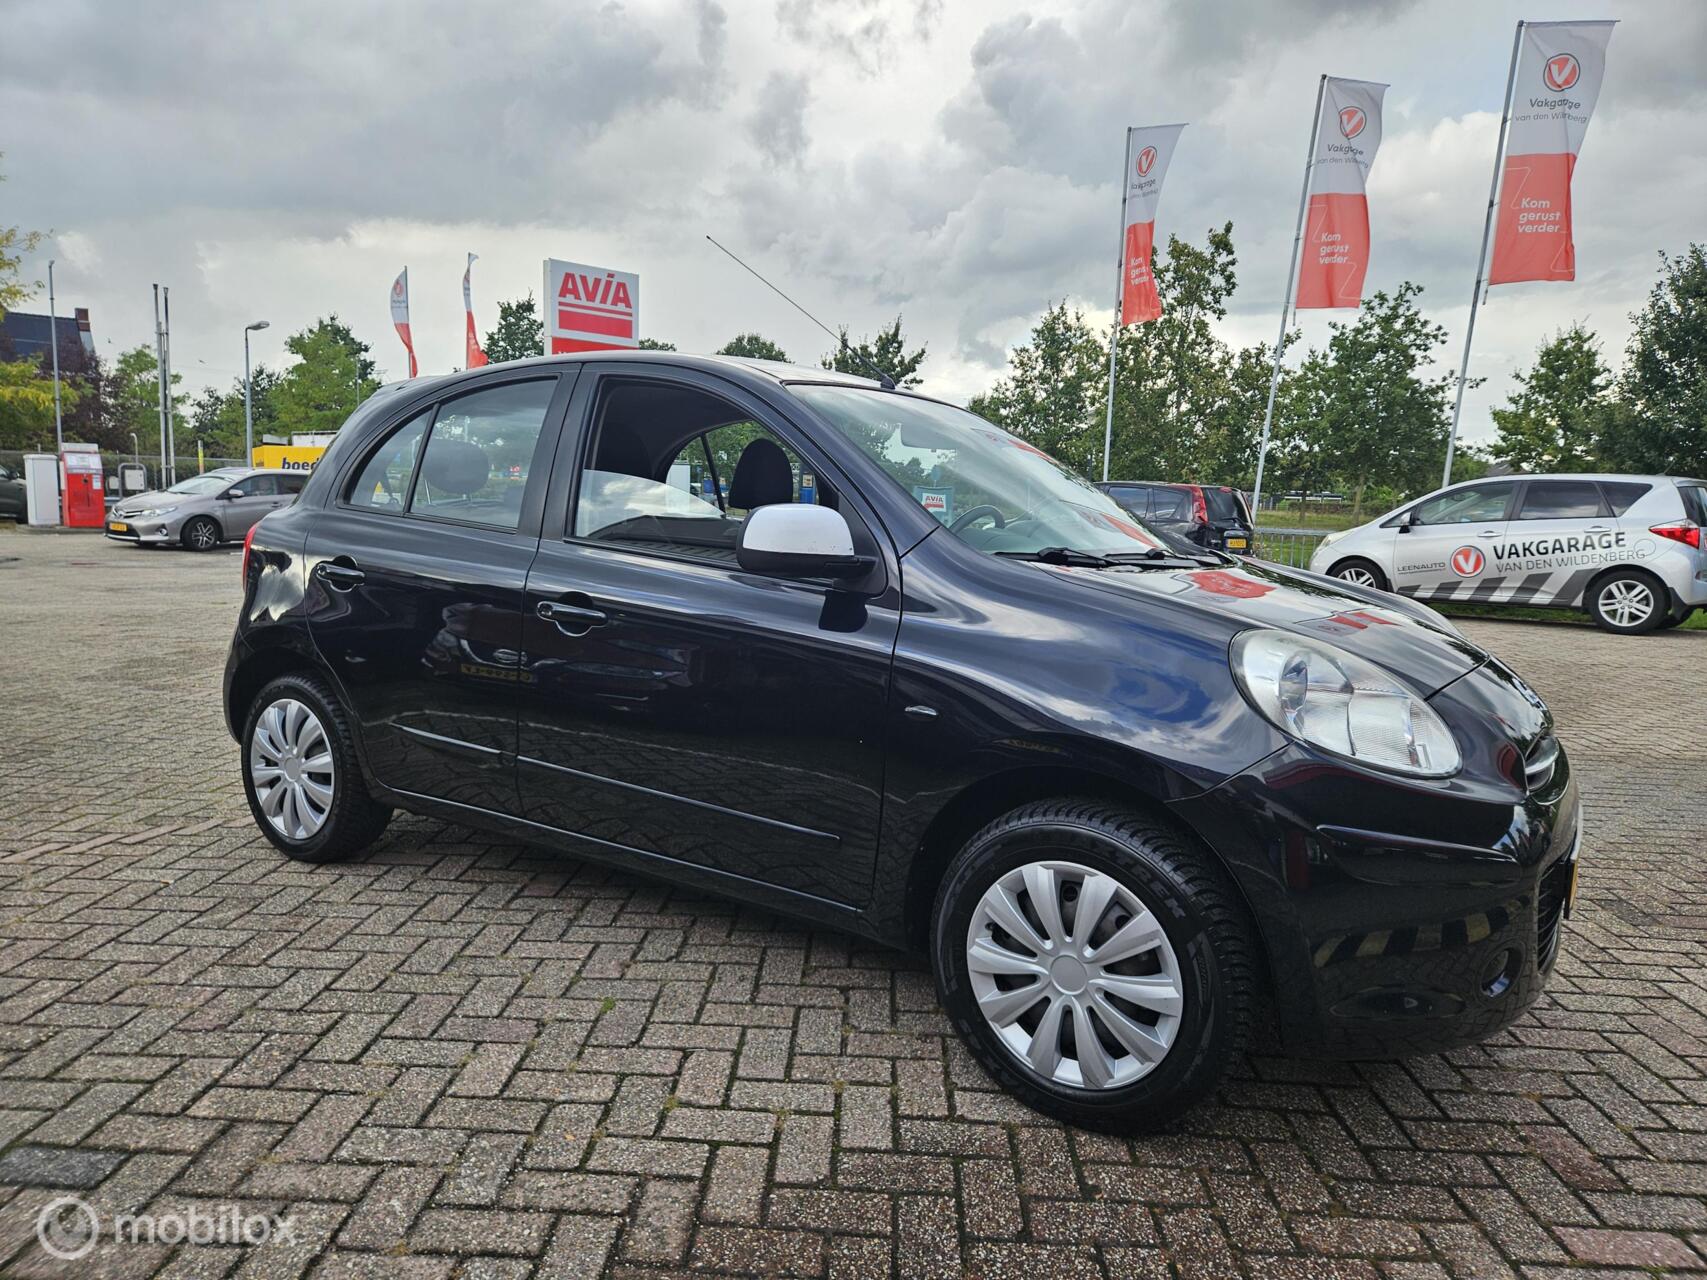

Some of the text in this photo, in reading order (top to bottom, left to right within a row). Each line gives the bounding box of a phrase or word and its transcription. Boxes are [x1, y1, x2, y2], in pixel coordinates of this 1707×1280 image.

[1521, 197, 1551, 209] Kom
[1519, 212, 1561, 224] gerust
[1518, 222, 1560, 233] verder
[1321, 231, 1341, 242] Kom
[1320, 243, 1349, 256] gerust
[1319, 254, 1348, 264] verder
[558, 272, 632, 309] AVIA
[1493, 532, 1626, 560] VAKGARAGE
[1397, 562, 1446, 572] LEENAUTO
[1496, 549, 1646, 573] VAN DEN WILDENBERG
